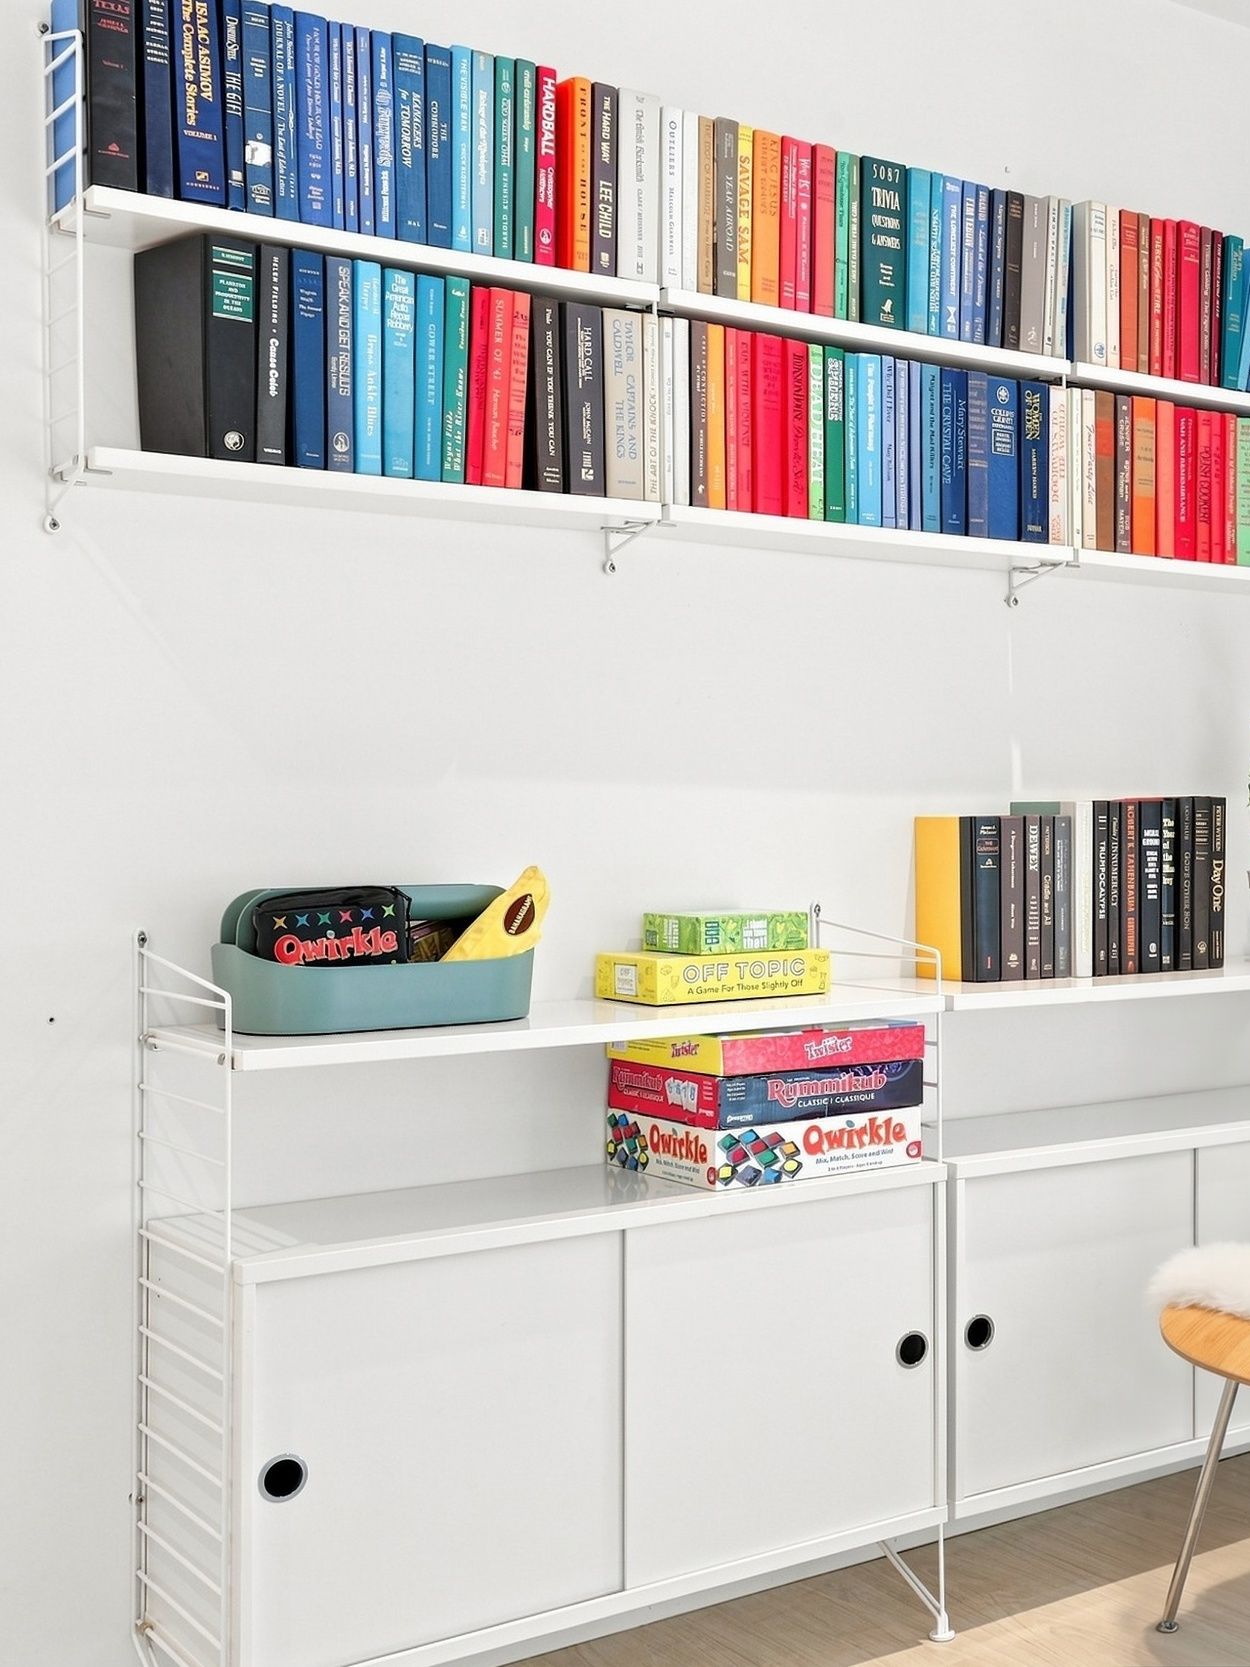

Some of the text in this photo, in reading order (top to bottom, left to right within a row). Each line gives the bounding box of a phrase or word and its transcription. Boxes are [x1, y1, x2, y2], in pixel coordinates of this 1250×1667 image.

[274, 19, 284, 61] JOURNAL
[285, 21, 293, 39] John
[182, 24, 197, 81] Complete
[195, 1, 213, 102] ISAAC ASIMOV
[276, 63, 284, 73] OF
[186, 83, 198, 124] Stories
[226, 71, 242, 116] THE GIFT
[277, 83, 285, 112] NOVEL
[460, 59, 468, 131] THE VISIBLE MAN
[278, 122, 286, 135] The
[412, 92, 421, 148] MANAGERS
[431, 101, 439, 159] COMMODORE
[541, 76, 555, 155] HARDBALL
[601, 96, 612, 164] THE HARD WAY
[376, 107, 392, 167] Speaking
[401, 104, 412, 167] TOMORROW
[501, 144, 509, 166] WHO
[669, 121, 678, 176] OUTLIERS
[279, 158, 287, 173] Eden
[538, 168, 546, 202] Matthews
[769, 139, 777, 216] KING JESUS
[872, 163, 900, 183] 5087
[279, 175, 287, 196] Letters
[546, 167, 555, 209] Christopher
[872, 186, 901, 211] TRIVIA
[599, 180, 612, 238] LEE CHILD
[725, 175, 733, 251] YEAR ABROAD
[738, 155, 749, 265] SAVAGE SAM
[339, 266, 350, 395] SPEAK AND GET RESULTS
[612, 319, 623, 376] CALDWELL
[624, 321, 634, 362] TAYLOR
[269, 338, 279, 368] Cause
[547, 366, 553, 375] IF
[584, 327, 593, 381] HARD CALL
[269, 370, 279, 396] Celeb
[1025, 390, 1032, 405] OF
[455, 402, 463, 426] River
[547, 394, 555, 420] THINK
[626, 374, 637, 460] CAPTAINS AND
[811, 363, 823, 485] DEAD HEAT
[1031, 393, 1039, 440] WOMEN
[615, 400, 625, 459] THE KINGS
[942, 382, 951, 484] THE CRYSTAL CAVE
[957, 400, 966, 471] Mary Stewart
[650, 446, 656, 457] OF
[1086, 483, 1095, 504] Line
[1199, 446, 1211, 524] POLISH COOKERY
[1127, 806, 1135, 840] ROBERT
[1029, 825, 1038, 872] DEWEY
[1044, 875, 1052, 900] Cradle
[1211, 859, 1223, 883] Day
[1213, 885, 1224, 912] One
[1044, 915, 1052, 926] All
[274, 926, 398, 965] Qwirkle
[683, 958, 806, 984] OFF TOPIC
[696, 986, 719, 994] Game
[736, 984, 759, 992] Those
[762, 981, 789, 992] Slightly
[791, 979, 803, 988] Off
[671, 1040, 700, 1058] Twister
[804, 1036, 853, 1060] Twister
[767, 1071, 887, 1108] Rummikub
[798, 1093, 875, 1108] CLASSIC CLASSIQUE
[649, 1124, 707, 1164] Qwirkle
[803, 1117, 908, 1156] Qwirkle
